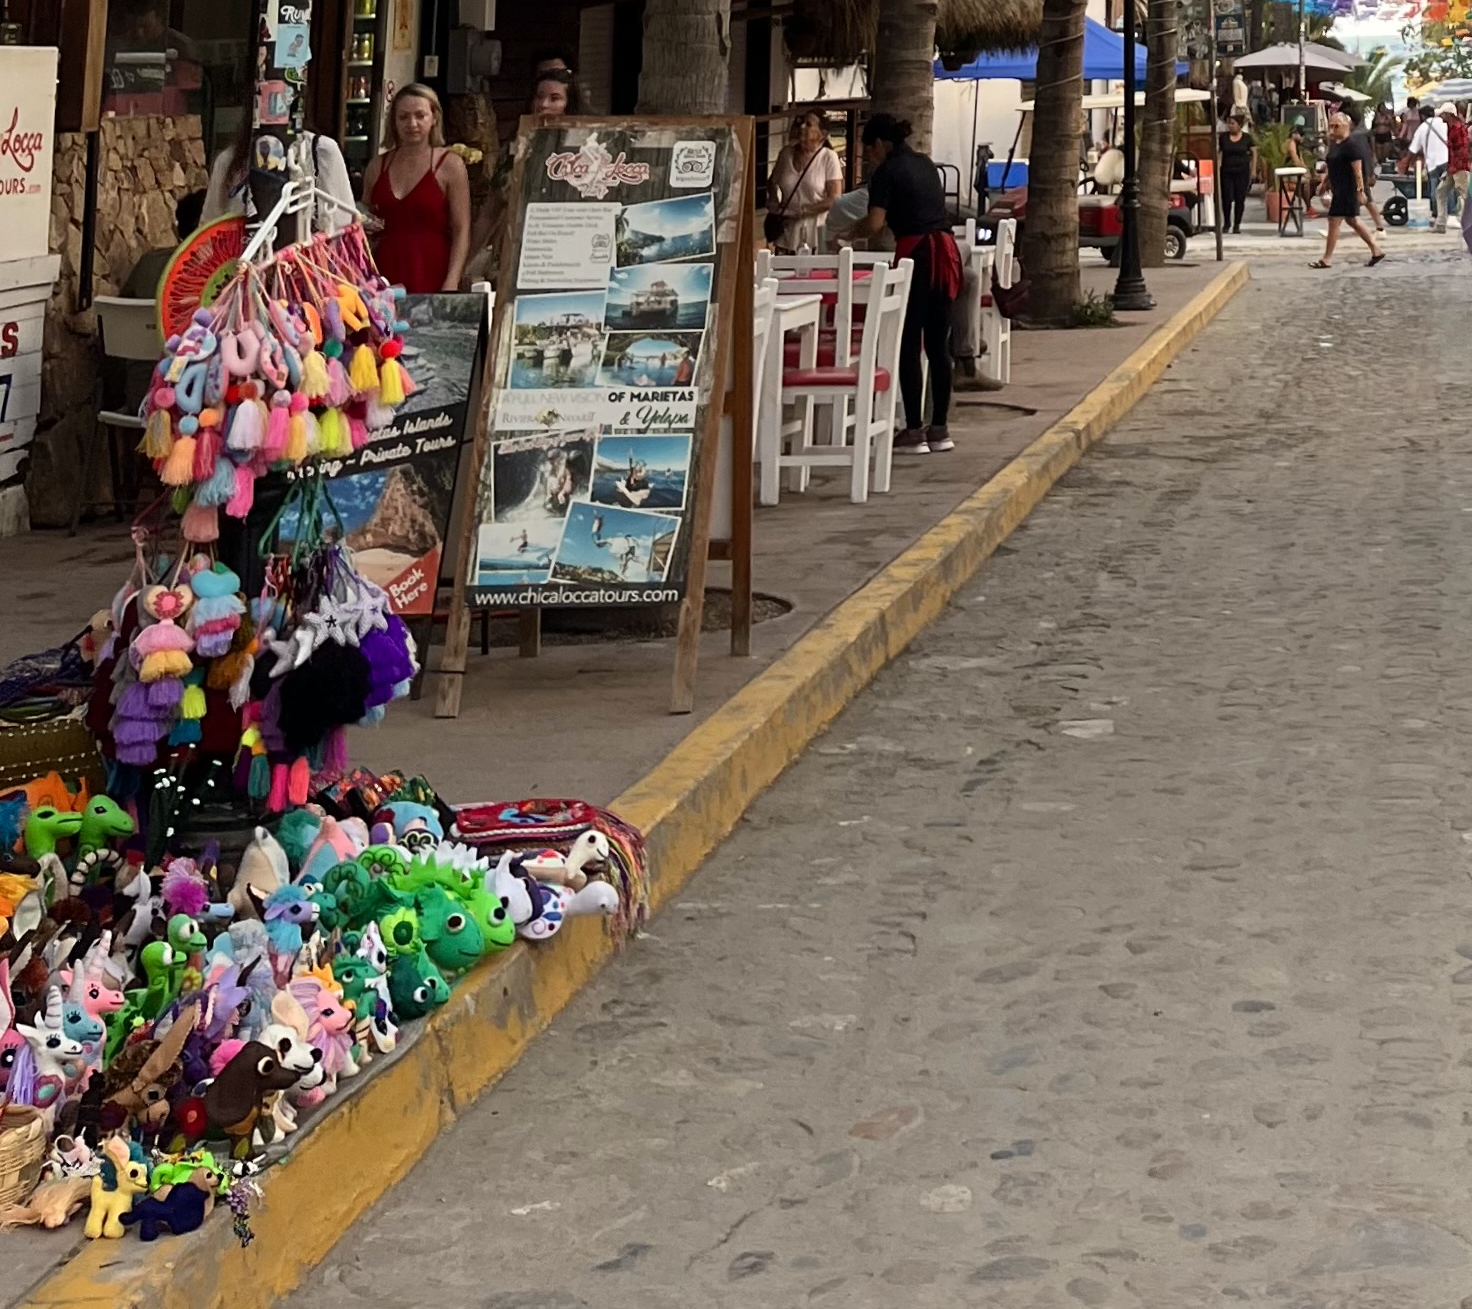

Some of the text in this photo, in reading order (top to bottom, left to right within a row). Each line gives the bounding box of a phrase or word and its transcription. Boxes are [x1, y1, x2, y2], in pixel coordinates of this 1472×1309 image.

[2, 107, 43, 172] Locca
[565, 391, 605, 403] VISION
[608, 391, 694, 402] OF MARIETAS
[403, 412, 453, 435] Islands
[619, 405, 689, 434] & Yelapa
[360, 435, 456, 466] Private Tours
[389, 568, 424, 598] Book
[395, 582, 428, 609] Here
[475, 586, 679, 605] www.chicaloccatours.com
